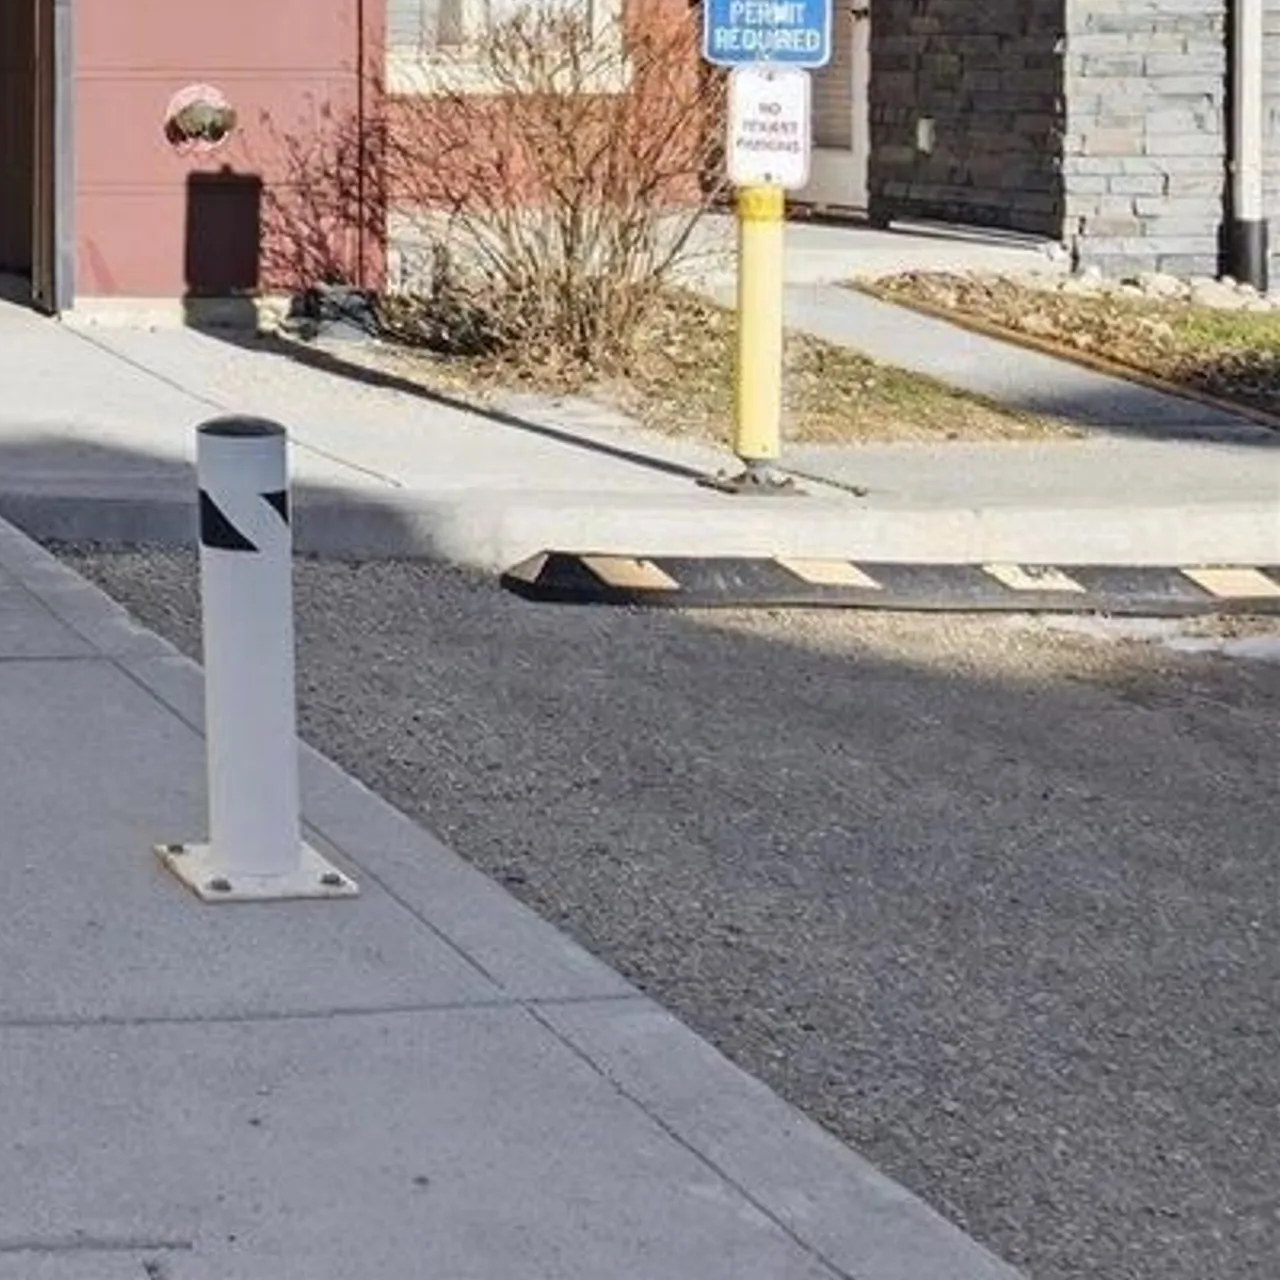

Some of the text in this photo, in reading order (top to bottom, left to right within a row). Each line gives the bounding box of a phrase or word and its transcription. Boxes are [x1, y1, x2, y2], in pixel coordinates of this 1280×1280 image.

[729, 0, 807, 24] PERMIT
[714, 27, 821, 52] REQUIRED
[757, 102, 782, 116] NO
